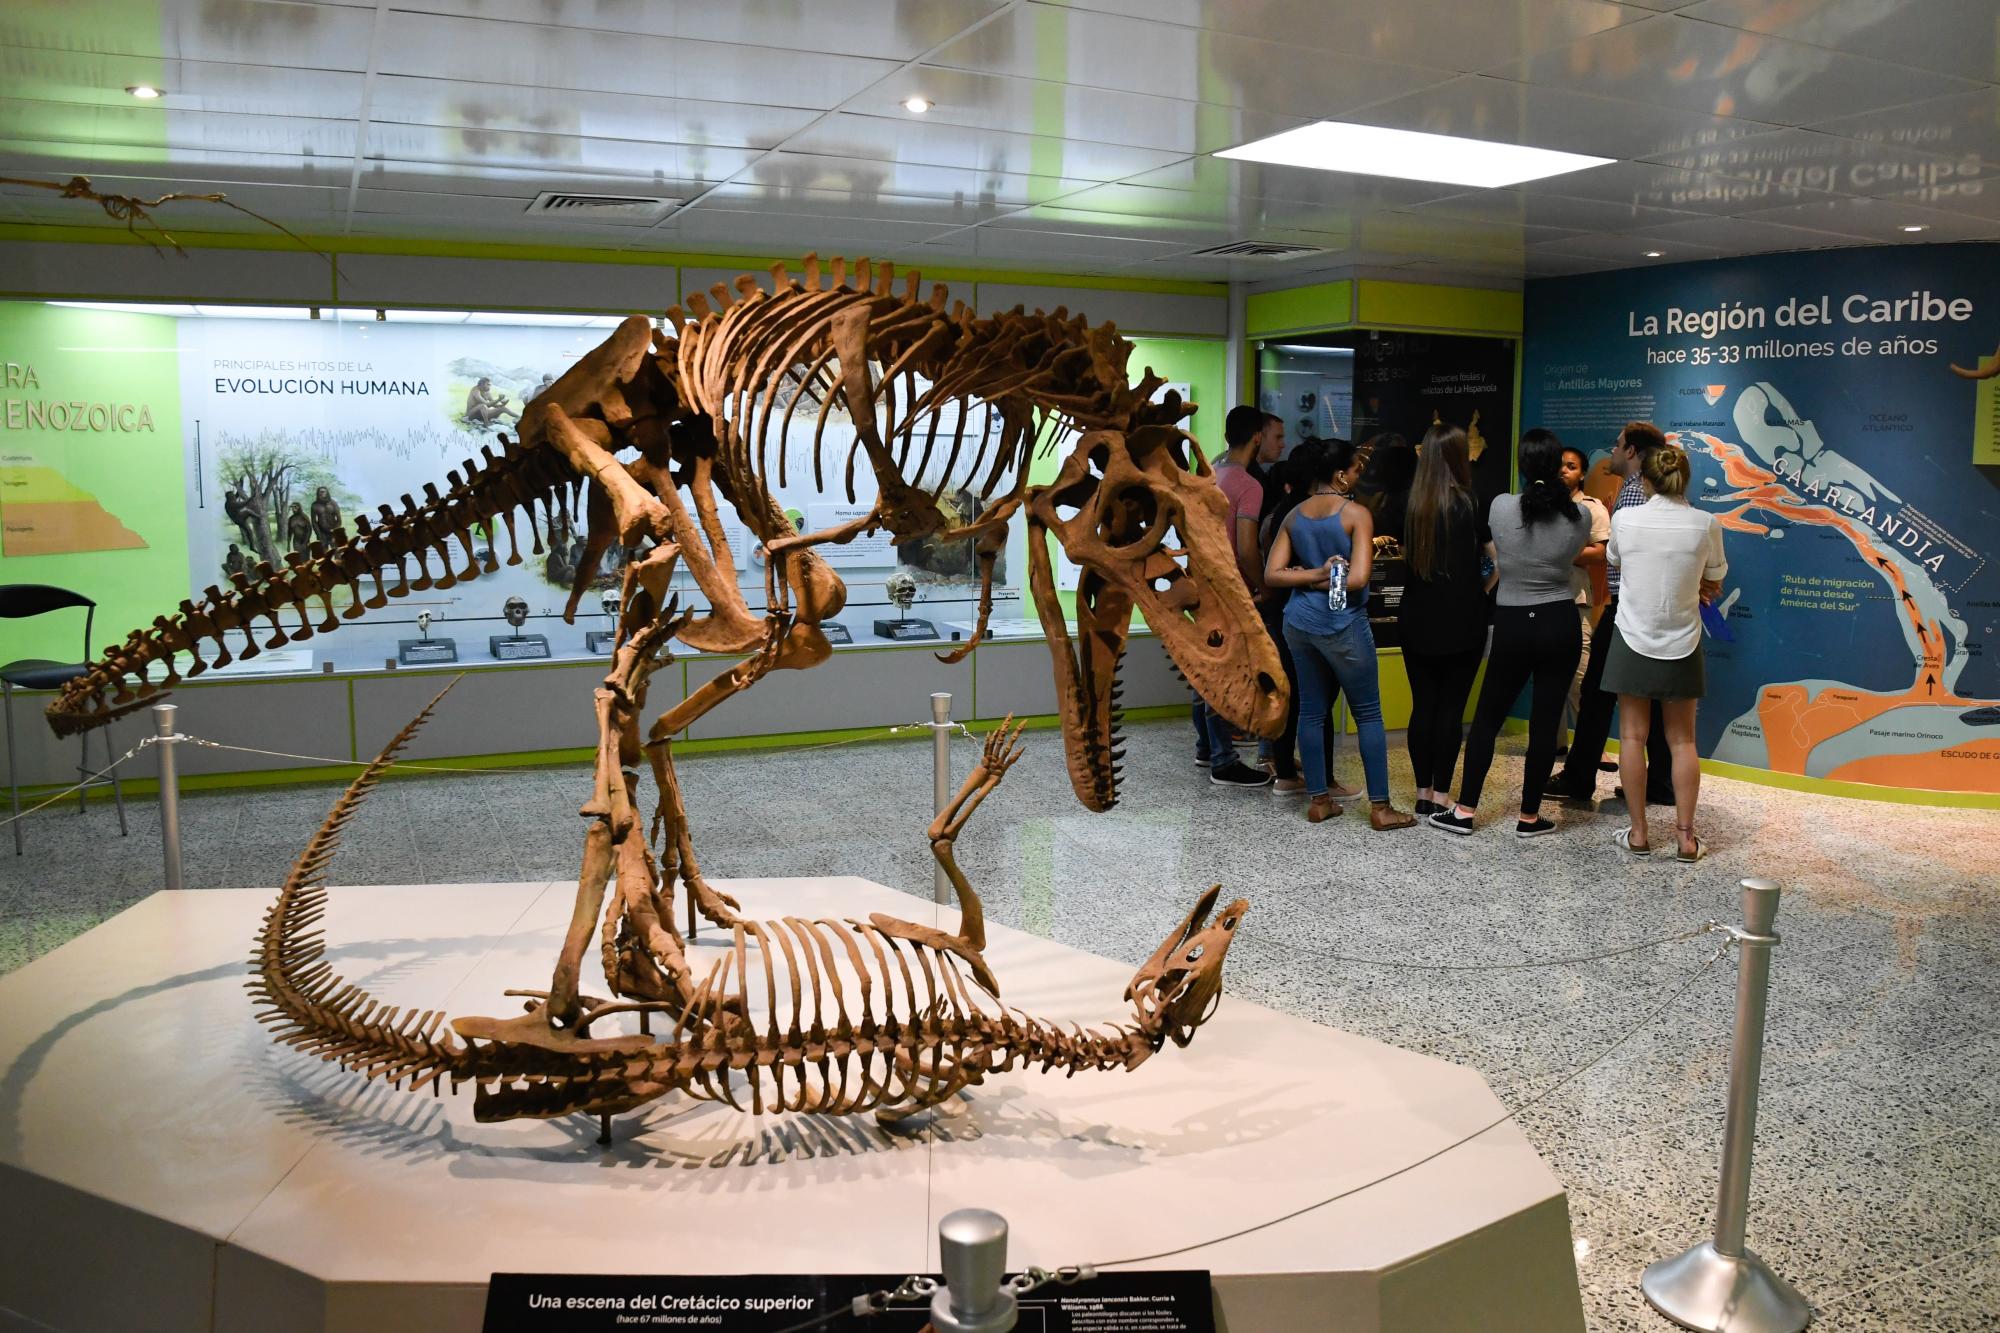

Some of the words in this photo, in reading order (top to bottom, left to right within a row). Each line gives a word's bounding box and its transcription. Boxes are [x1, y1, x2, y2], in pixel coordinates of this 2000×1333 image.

[1629, 312, 1658, 336] La
[1667, 302, 1765, 339] Región
[1775, 298, 1832, 327] del
[1842, 291, 1973, 323] Caribe
[1647, 348, 1686, 364] hace
[1690, 345, 1740, 366] 35-33
[1745, 339, 1835, 359] millones
[1841, 336, 1872, 356] de
[1879, 335, 1938, 355] años
[214, 360, 294, 371] PRINCIPALES
[298, 361, 335, 372] HITOS
[338, 362, 354, 372] DE
[358, 362, 373, 372] LA
[215, 376, 334, 394] EVOLUCIÓN
[341, 380, 430, 395] HUMANA
[1558, 380, 1595, 390] Antillas
[1598, 378, 1642, 392] Mayores
[6, 399, 154, 432] ENOZOICA
[1772, 457, 1945, 574] GAARLANDIA
[1781, 574, 1806, 584] "Ruta
[1808, 576, 1822, 586] de
[1823, 578, 1875, 589] migración
[1780, 586, 1792, 595] de
[1794, 587, 1822, 597] fauna
[1823, 590, 1855, 600] desde
[1780, 598, 1818, 609] América
[1820, 600, 1836, 610] del
[1838, 602, 1860, 612] Sur"
[1870, 728, 1890, 738] Pasaje
[1916, 732, 1944, 740] Orinoco
[1941, 750, 1978, 759] ESCUDO
[1979, 752, 1992, 760] DE
[529, 1294, 562, 1309] Una
[566, 1297, 626, 1310] escena
[630, 1294, 657, 1310] del
[661, 1294, 741, 1310] Cretácico
[744, 1296, 814, 1313] superior
[616, 1314, 638, 1324] (hace
[640, 1315, 650, 1324] 67
[652, 1314, 687, 1324] millones
[687, 1314, 699, 1324] de
[700, 1314, 722, 1325] años)
